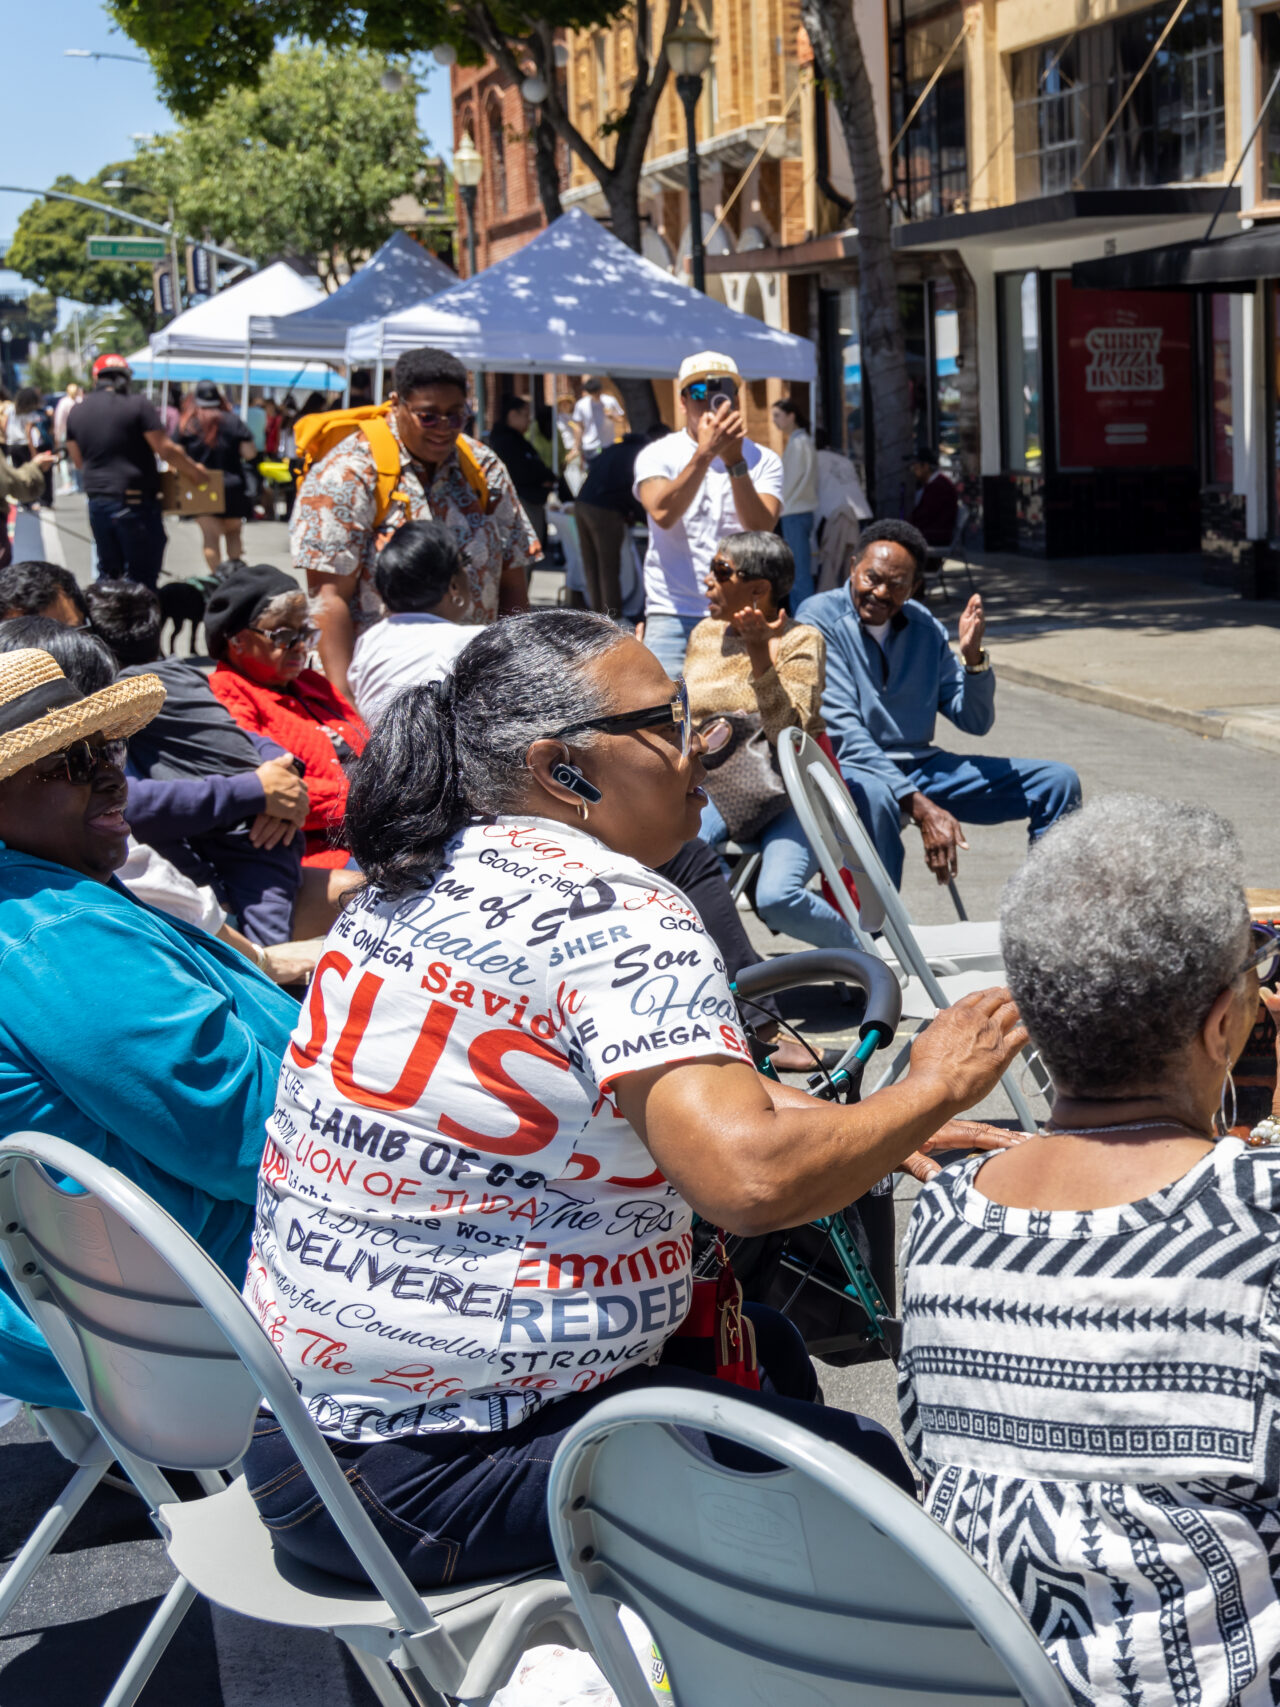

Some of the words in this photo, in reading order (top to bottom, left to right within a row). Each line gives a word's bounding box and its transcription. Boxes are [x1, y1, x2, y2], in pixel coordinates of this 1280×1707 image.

[1089, 331, 1160, 350] CURRY
[1096, 350, 1153, 368] PIZZA
[1090, 368, 1161, 387] HOUSE
[434, 879, 475, 901] on
[479, 893, 533, 930] of
[353, 929, 414, 973] OMEGA
[390, 895, 537, 986] Healer
[611, 943, 701, 989] Son
[601, 1023, 711, 1065] OMEGA
[309, 1098, 411, 1163] LAMB
[419, 1141, 483, 1182] OF
[295, 1133, 357, 1186] LION
[363, 1171, 422, 1204] OF
[526, 1184, 603, 1231] The
[295, 1328, 357, 1375] The
[500, 1338, 649, 1376] STRONG
